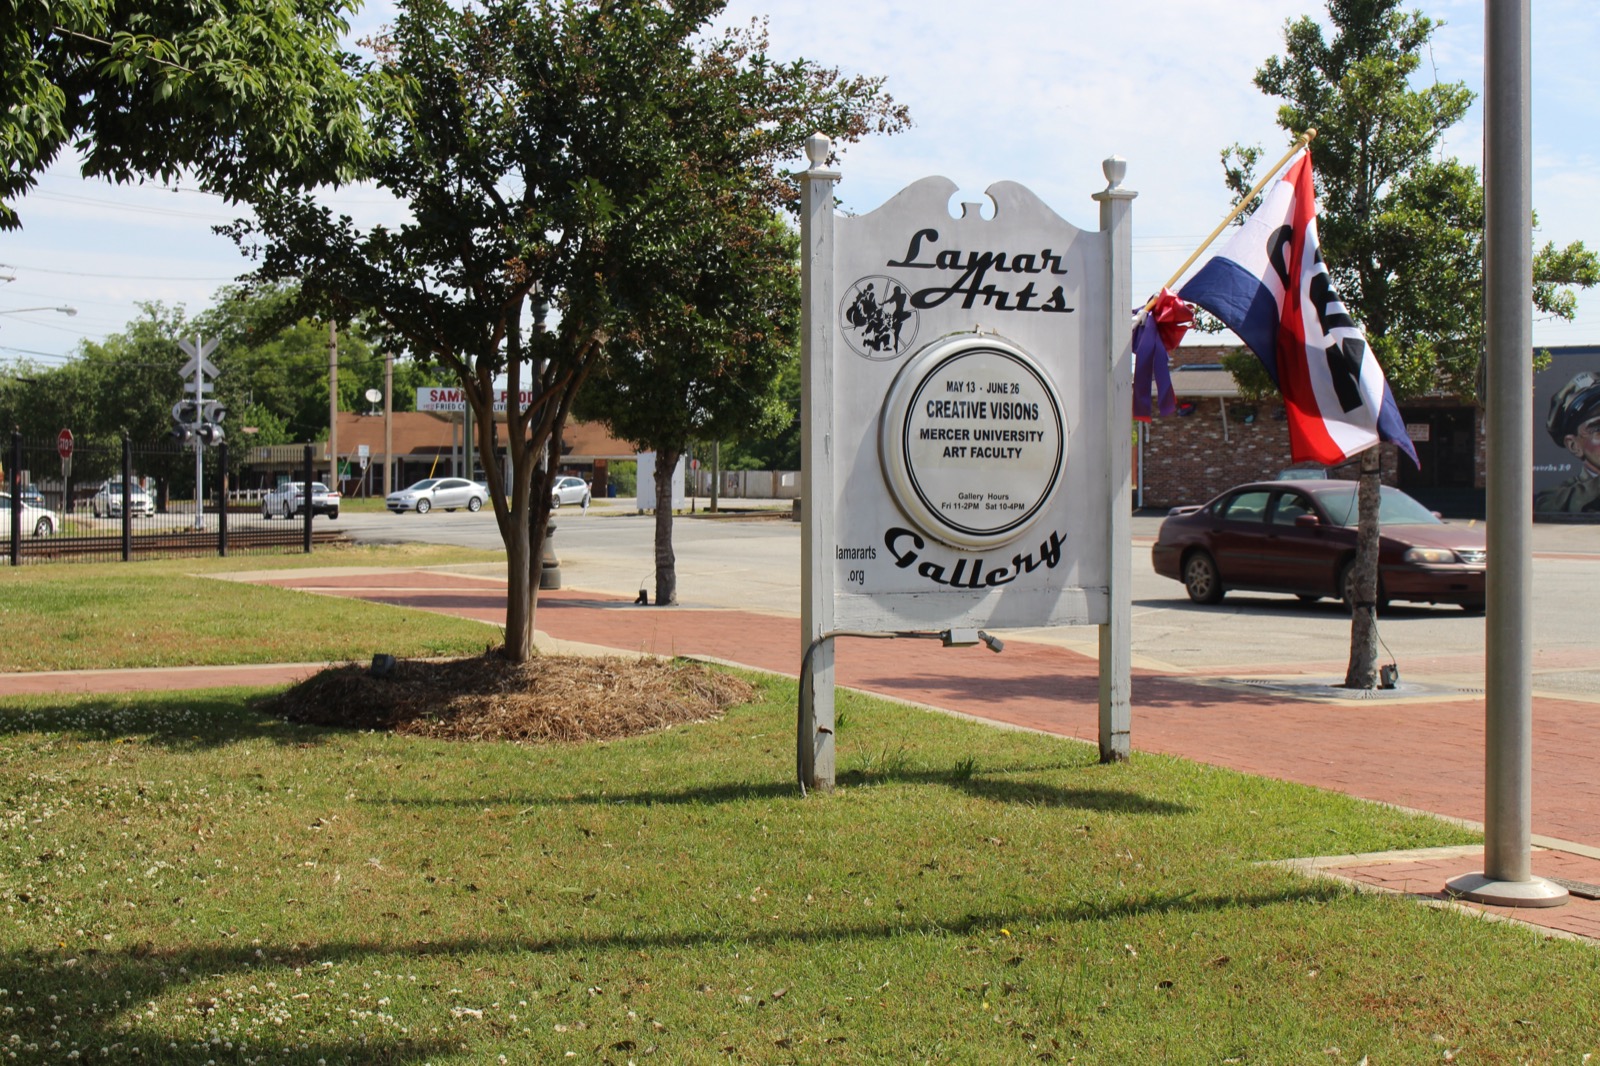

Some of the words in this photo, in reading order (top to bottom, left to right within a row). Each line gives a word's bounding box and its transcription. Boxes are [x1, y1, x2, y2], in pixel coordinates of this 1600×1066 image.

[886, 228, 1068, 275] Lamar
[910, 254, 1075, 313] Arts
[1266, 224, 1366, 414] OEN
[946, 381, 964, 394] MAY
[966, 381, 976, 393] 13
[986, 382, 1008, 394] JUNE
[1009, 382, 1020, 395] 26
[926, 400, 987, 419] CREATIVE
[990, 402, 1039, 421] VISIONS
[919, 428, 970, 441] MERCER
[973, 429, 1044, 442] UNIVERSITY
[942, 446, 967, 458] ART
[970, 446, 1022, 459] FACULTY
[958, 492, 984, 502] Gallery
[987, 492, 1009, 501] Hours
[941, 502, 952, 510] Fri
[953, 502, 980, 510] 11-2PM
[985, 502, 997, 510] Sat
[999, 503, 1025, 511] 10-4PM
[835, 544, 877, 560] lamararts
[884, 526, 1067, 588] Gallery
[847, 568, 865, 585] .org
